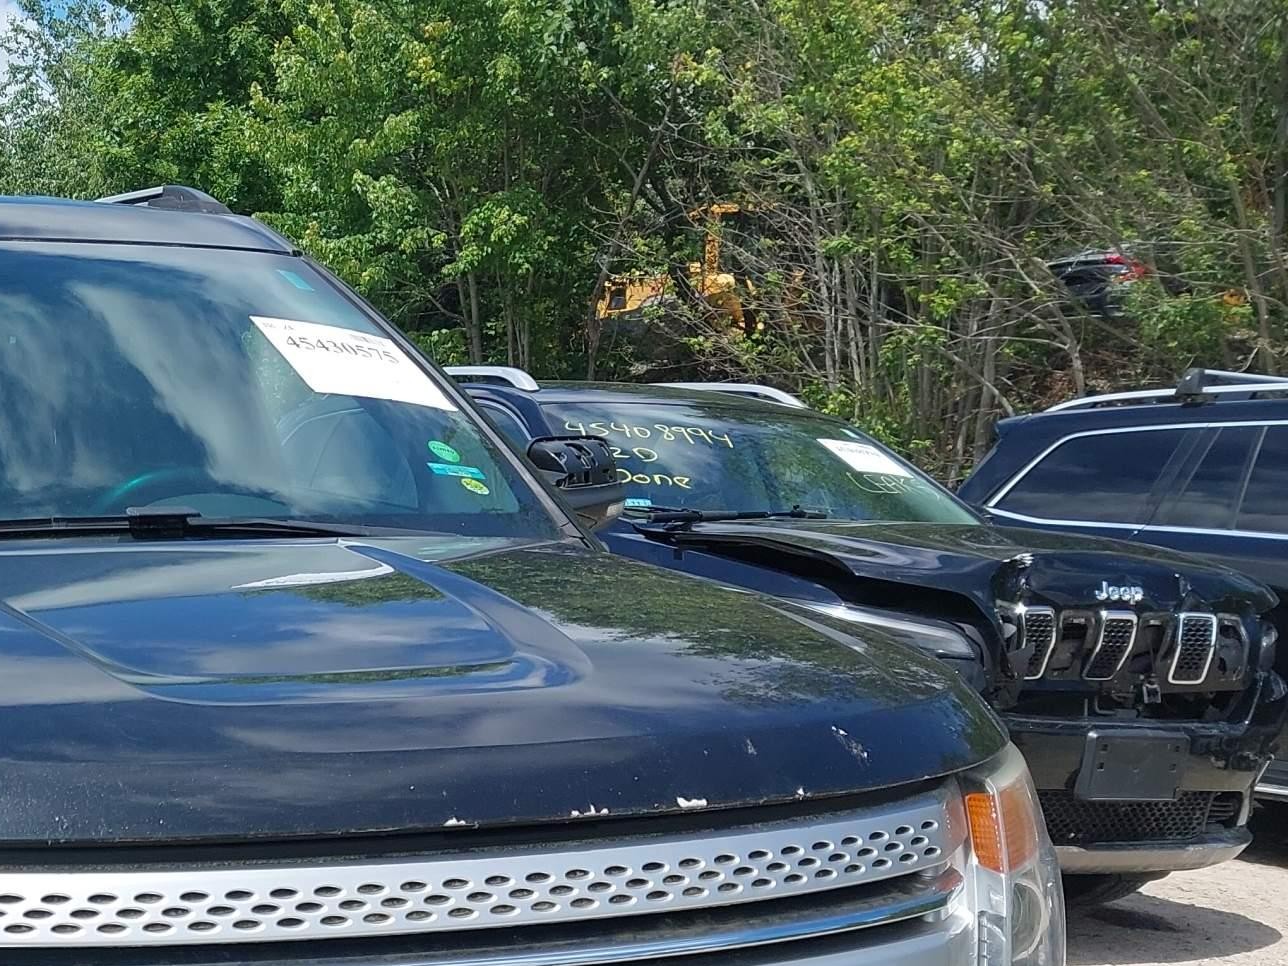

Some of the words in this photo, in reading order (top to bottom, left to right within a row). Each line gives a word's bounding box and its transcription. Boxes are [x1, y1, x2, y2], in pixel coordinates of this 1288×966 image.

[286, 335, 400, 364] 45430575
[564, 420, 734, 449] 45408994
[616, 468, 692, 489] Done
[1094, 580, 1145, 605] Jeep
